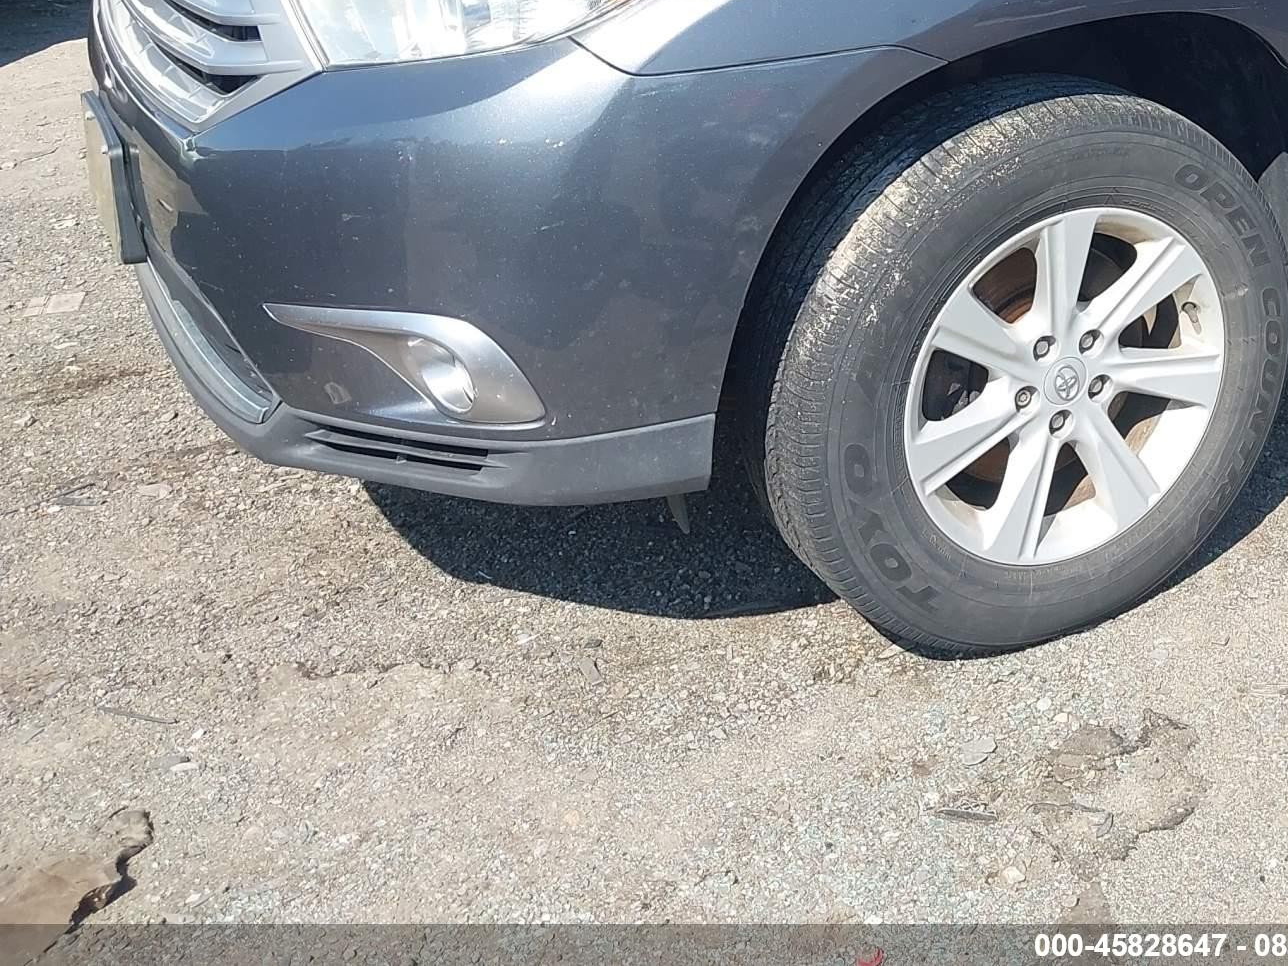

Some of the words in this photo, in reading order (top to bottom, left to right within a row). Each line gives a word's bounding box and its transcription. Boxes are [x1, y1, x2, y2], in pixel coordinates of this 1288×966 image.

[1174, 163, 1271, 267] OPEN
[1194, 286, 1283, 539] COUNTRY
[844, 443, 940, 612] TOYO
